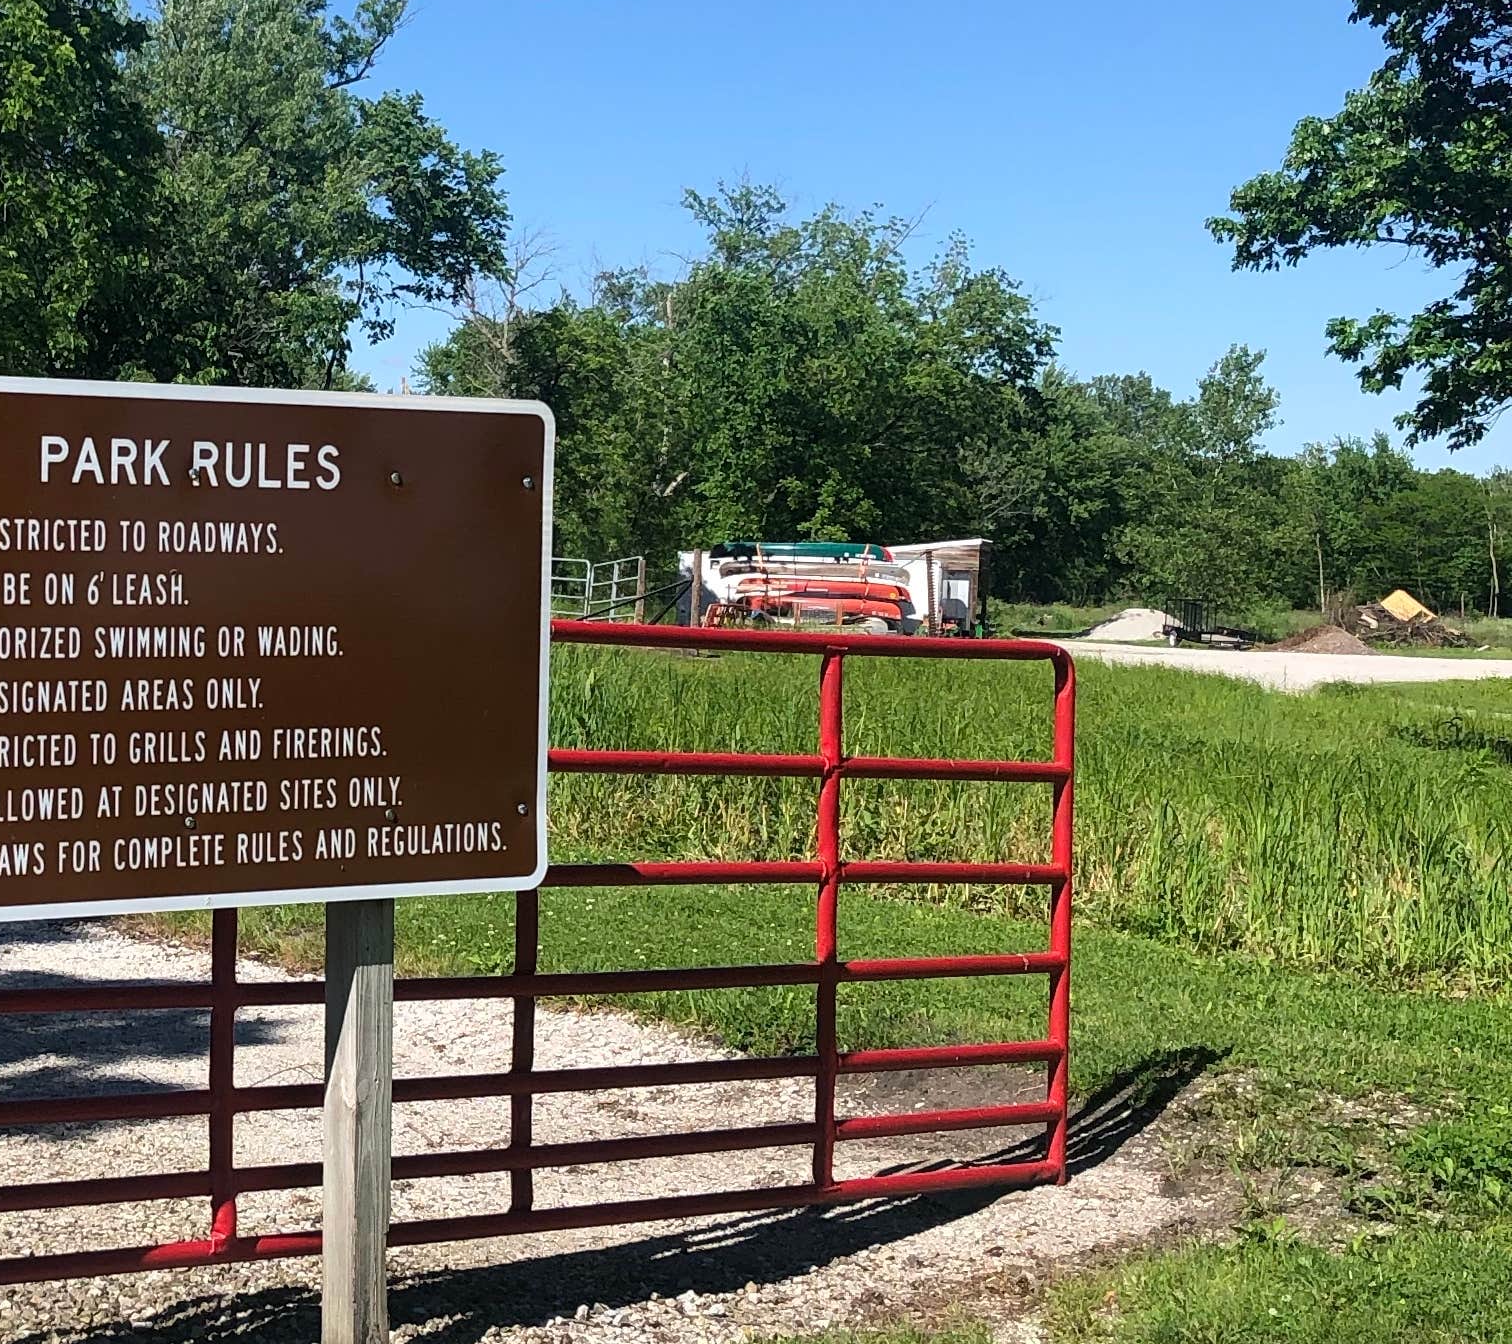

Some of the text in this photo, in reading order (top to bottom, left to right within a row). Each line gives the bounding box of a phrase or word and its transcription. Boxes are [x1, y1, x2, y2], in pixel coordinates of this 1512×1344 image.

[40, 435, 341, 490] PARK RULES
[119, 520, 146, 553] TO
[158, 521, 284, 554] ROADWAYS.
[3, 572, 31, 605] BE
[44, 572, 74, 605] ON
[112, 573, 189, 605] LEASH.
[94, 626, 205, 659] SWIMMING
[218, 626, 245, 658] OR
[257, 626, 343, 657] WADING.
[121, 678, 194, 711] AREAS
[206, 678, 263, 710] ONLY.
[90, 732, 116, 765] TO
[129, 730, 206, 764] GRILLS
[218, 729, 261, 761] AND
[273, 726, 387, 759] FIRERINGS.
[97, 785, 123, 818] AT
[135, 780, 267, 815] DESIGNATED
[279, 778, 337, 810] SITES
[349, 776, 403, 808] ONLY.
[58, 840, 101, 874] FOR
[114, 834, 225, 871] COMPLETE
[237, 830, 303, 864] RULES
[315, 828, 356, 860] AND
[367, 822, 507, 857] REGULATIONS.
